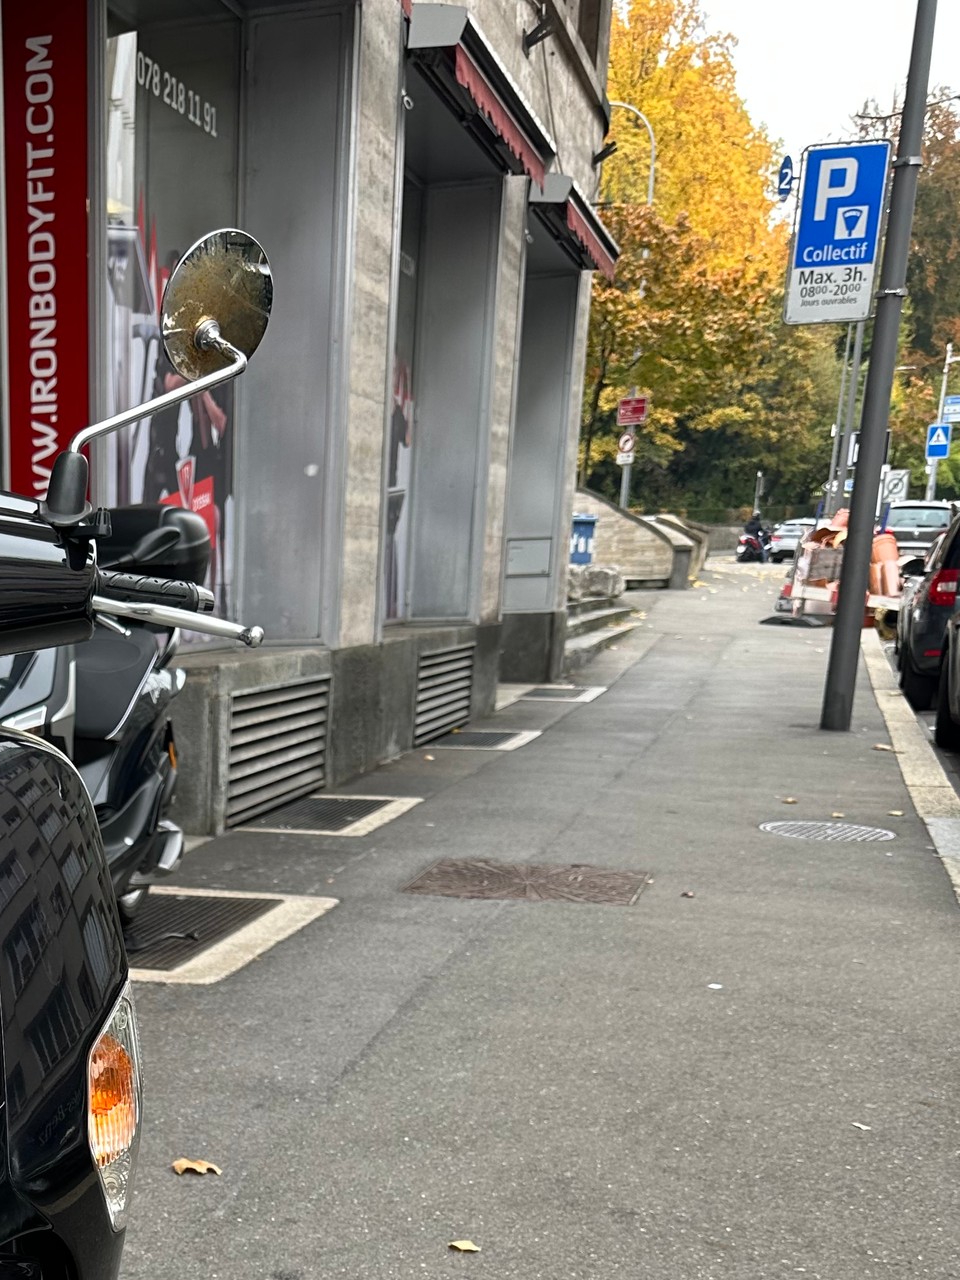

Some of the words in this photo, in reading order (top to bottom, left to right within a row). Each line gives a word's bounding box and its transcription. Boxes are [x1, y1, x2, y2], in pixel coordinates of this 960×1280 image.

[137, 51, 160, 97] 078
[163, 71, 185, 115] 218
[188, 90, 202, 127] 11
[203, 102, 218, 137] 91
[780, 168, 792, 190] 2
[813, 157, 859, 222] P
[802, 242, 869, 263] Collectif
[798, 270, 838, 286] Max.
[842, 266, 868, 283] 3h.
[820, 296, 858, 306] ouvrables
